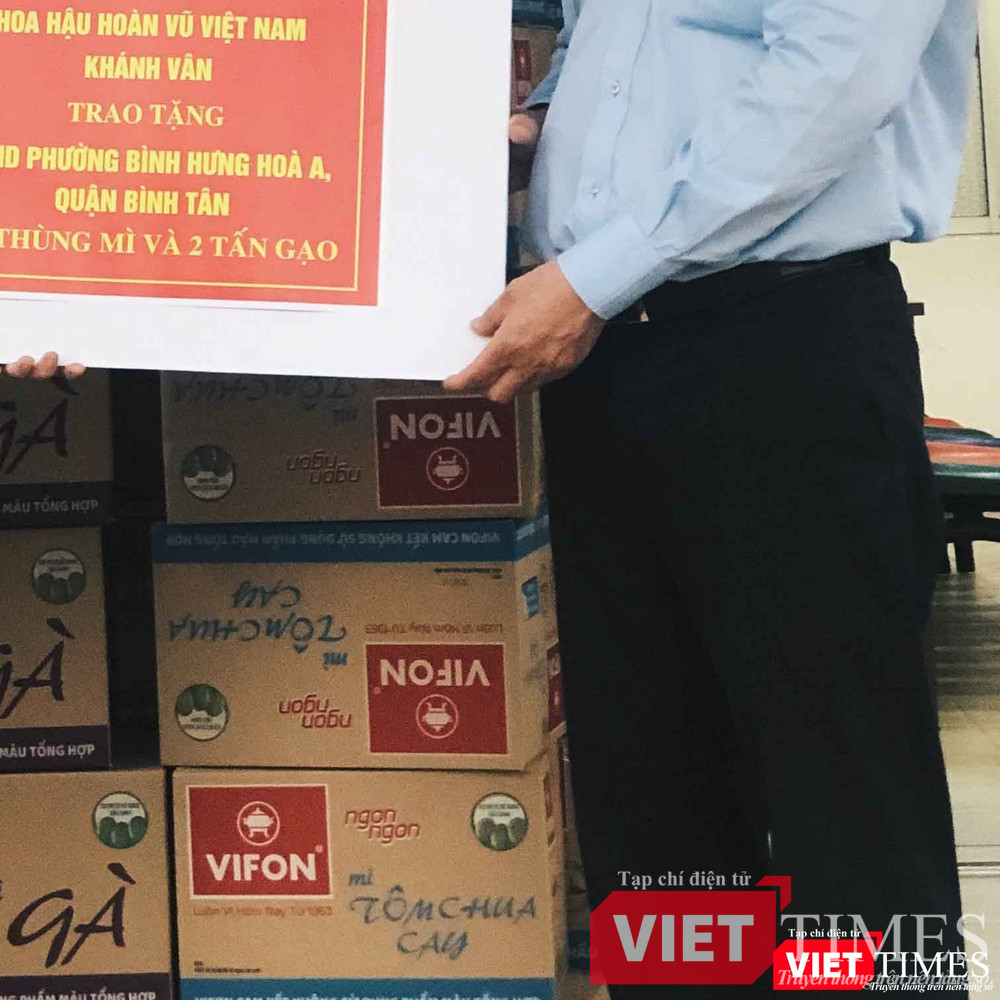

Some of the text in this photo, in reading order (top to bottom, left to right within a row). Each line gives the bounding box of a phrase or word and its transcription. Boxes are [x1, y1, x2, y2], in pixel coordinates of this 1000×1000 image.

[46, 7, 92, 40] HẬU
[98, 9, 158, 37] HOÀN
[166, 10, 194, 37] VŨ
[201, 11, 247, 44] VIỆT
[254, 17, 306, 41] NAM
[84, 52, 212, 81] KHÁNH VÂN
[68, 100, 224, 130] TRAO TẶNG
[26, 143, 118, 173] PHƯỜNG
[126, 144, 180, 174] BÌNH
[187, 150, 249, 176] HƯNG
[257, 149, 302, 178] HOÀ
[309, 155, 331, 182] A,
[55, 184, 229, 216] QUẬN BÌNH TÂN
[99, 226, 136, 254] MÌ
[143, 229, 180, 256] VÀ
[190, 236, 202, 256] 2
[209, 227, 266, 258] TẤN
[275, 238, 337, 264] GẠO
[389, 411, 502, 441] VIFON
[3, 498, 30, 513] MÀU
[33, 496, 68, 512] TỔNG
[72, 500, 98, 514] HỢP
[231, 580, 301, 610] CAY
[379, 658, 491, 687] VIFON
[278, 694, 330, 716] ngon
[301, 704, 352, 729] ngon
[0, 742, 26, 758] MÀU
[30, 739, 64, 757] TỔNG
[68, 744, 95, 758] HỢP
[344, 808, 396, 830] ngon
[368, 822, 420, 845] ngon
[205, 854, 317, 882] VIFON
[7, 862, 136, 969] GÀ
[397, 931, 469, 960] CAY
